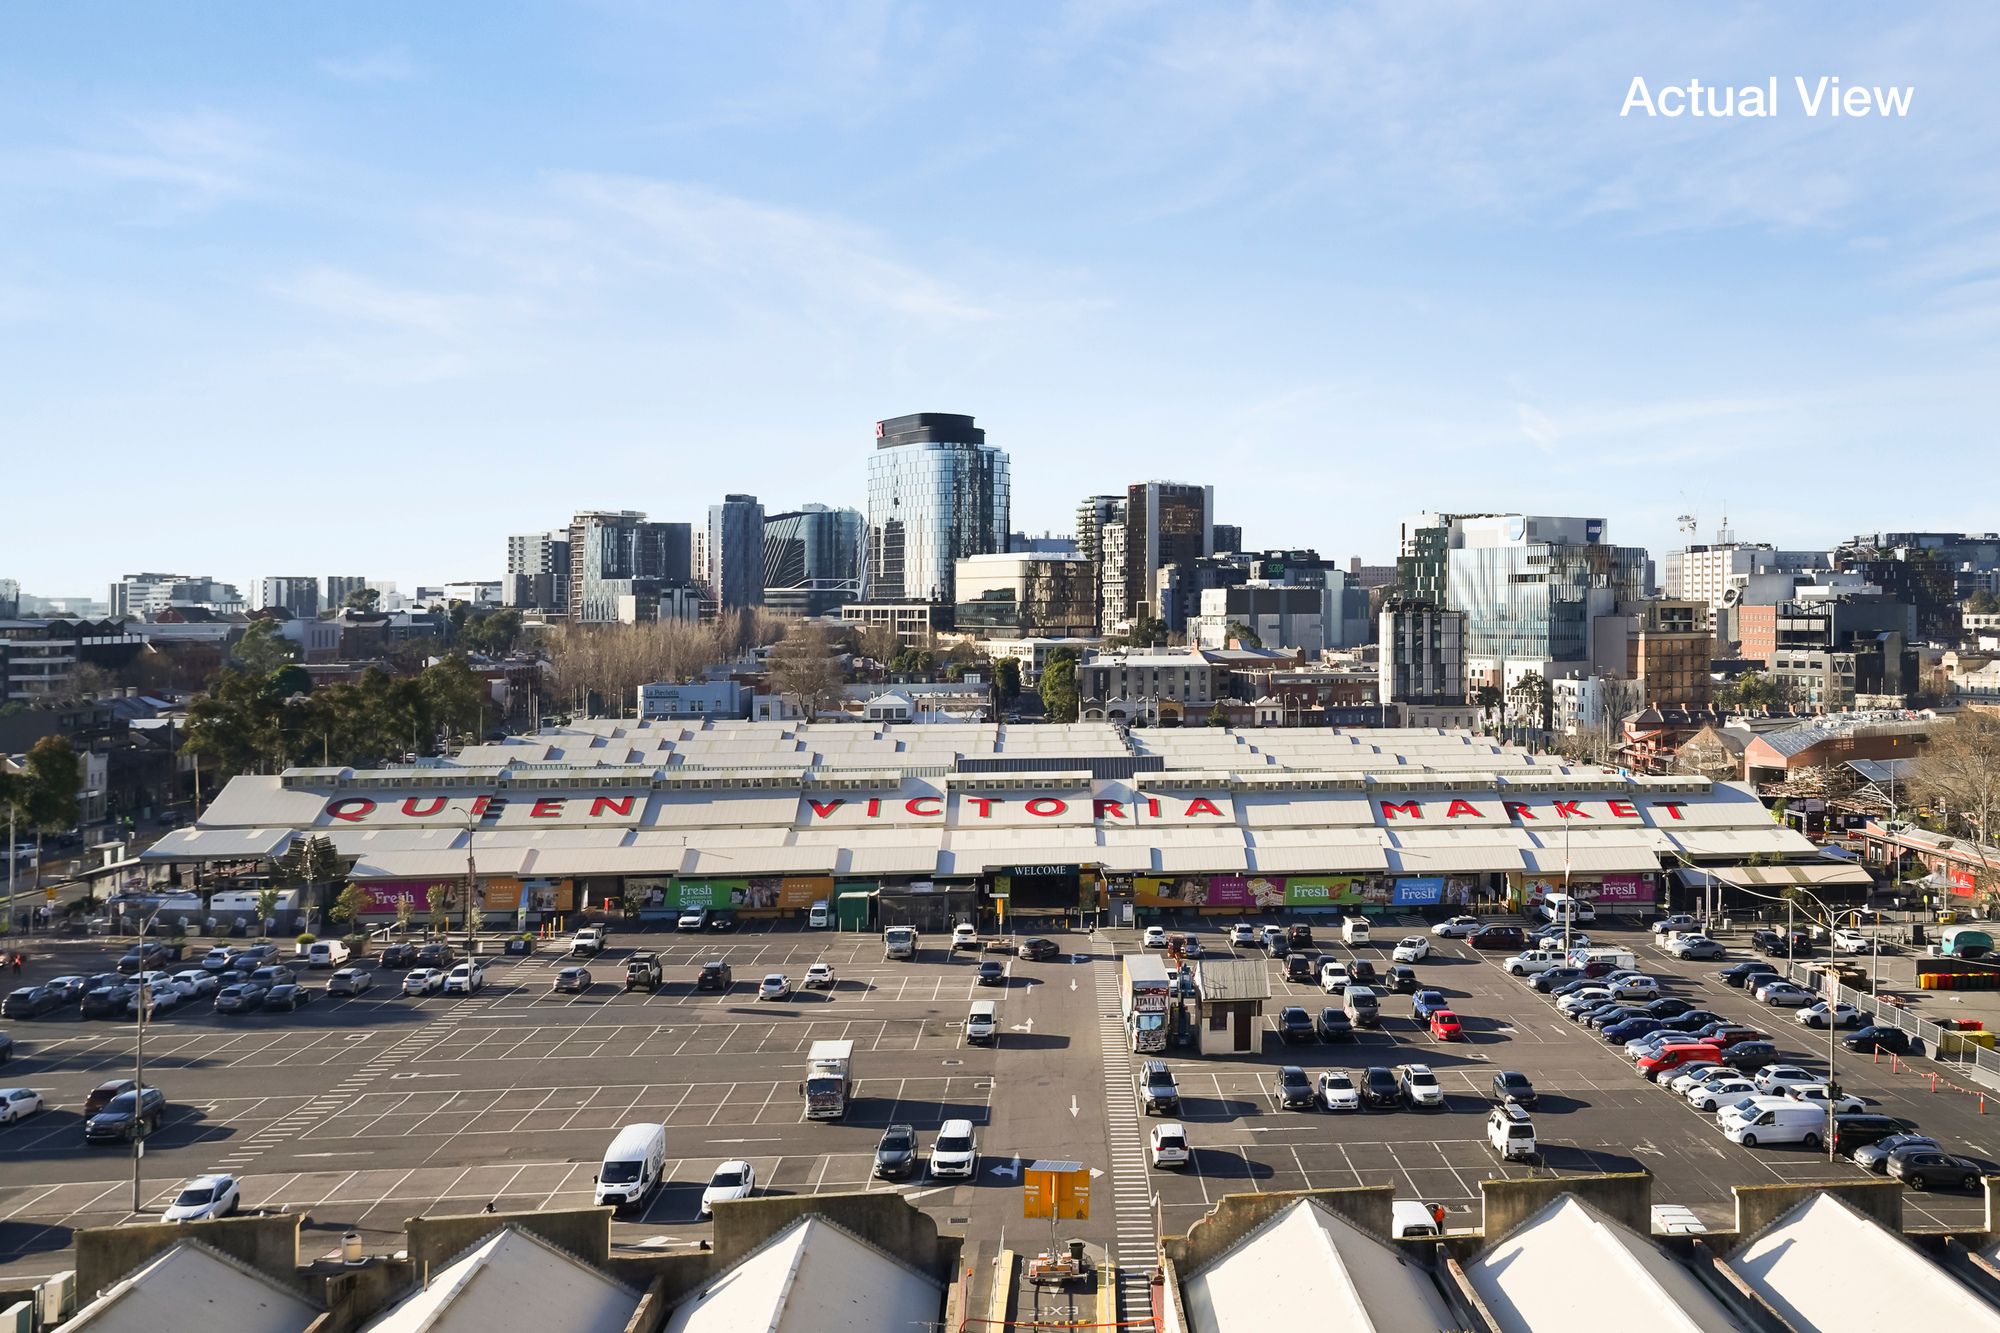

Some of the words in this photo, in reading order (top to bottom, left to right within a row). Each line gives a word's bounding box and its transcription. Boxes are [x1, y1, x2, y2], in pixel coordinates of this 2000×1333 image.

[326, 796, 637, 822] QUEEN
[807, 797, 1226, 819] VICTORIA
[1380, 798, 1688, 820] MARKET
[1015, 865, 1067, 876] WELCOME
[681, 885, 712, 896] Fresh
[1293, 885, 1330, 898] Fresh
[1401, 887, 1436, 900] Fresh
[1601, 883, 1637, 895] Fresh
[1136, 997, 1166, 1007] ITALIAN
[1029, 1306, 1079, 1316] EXIT
